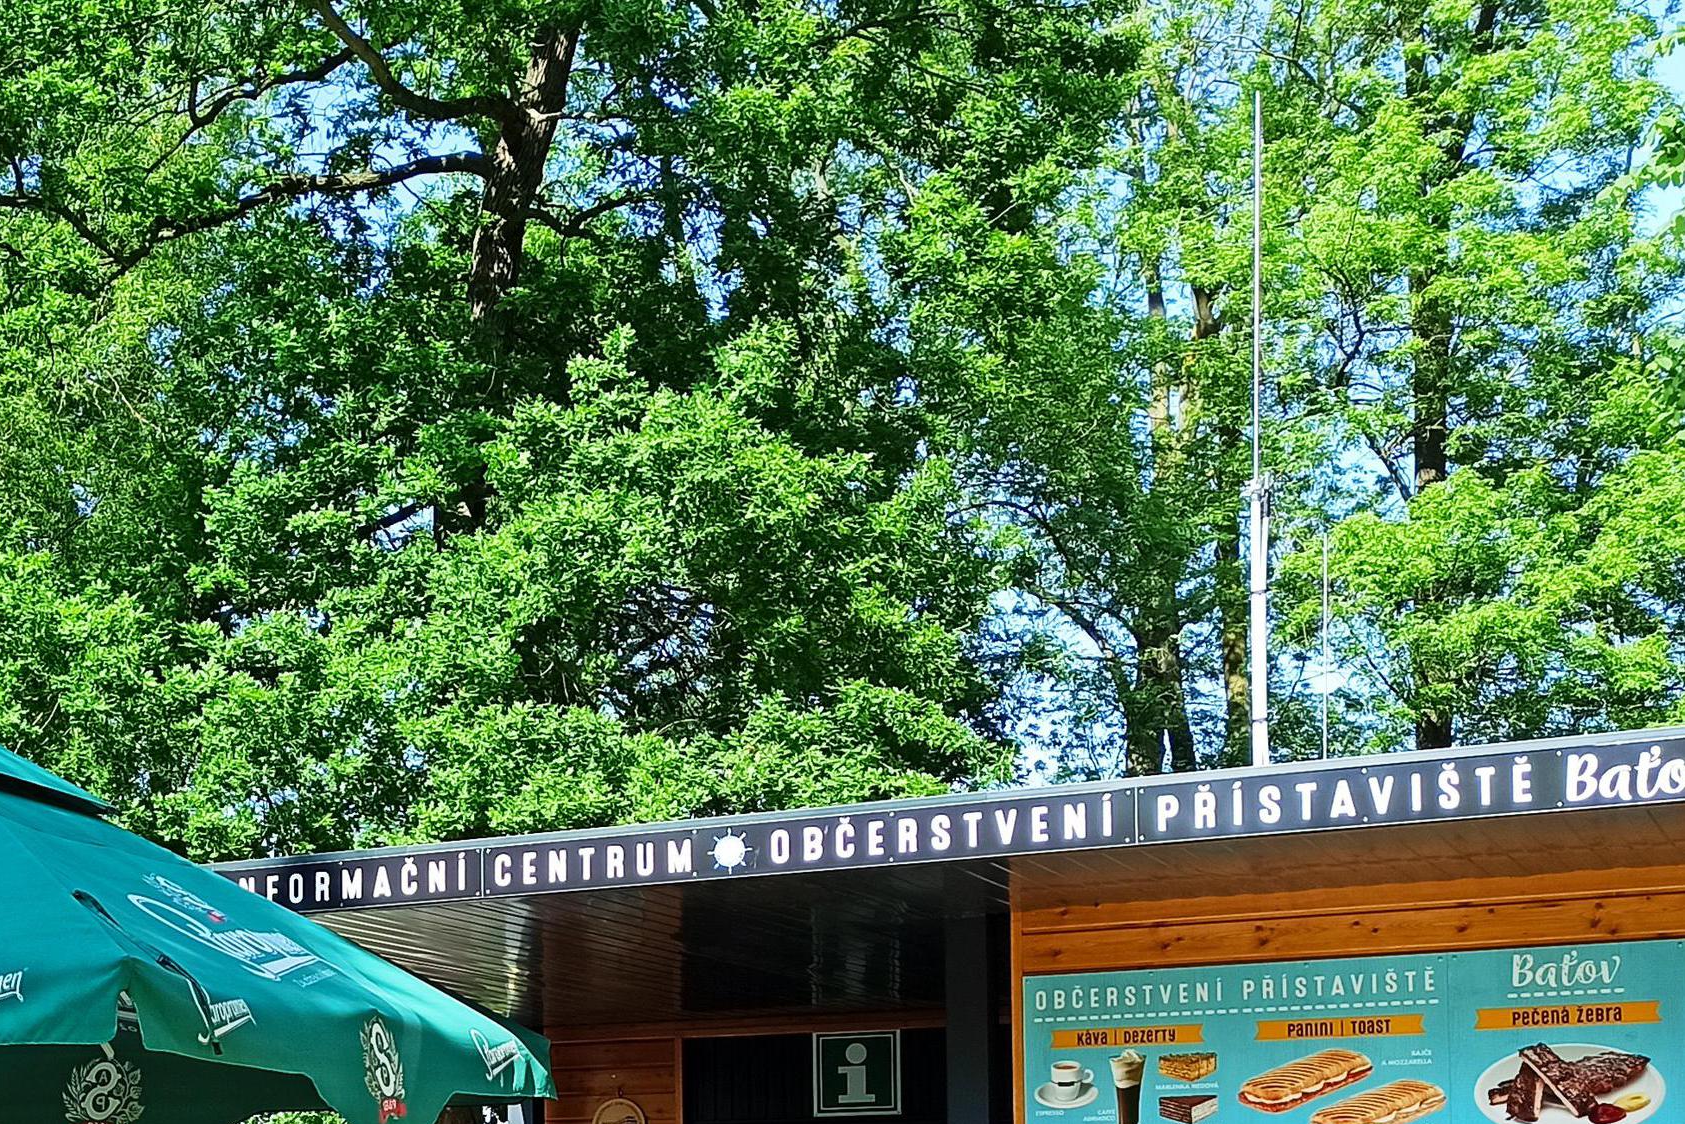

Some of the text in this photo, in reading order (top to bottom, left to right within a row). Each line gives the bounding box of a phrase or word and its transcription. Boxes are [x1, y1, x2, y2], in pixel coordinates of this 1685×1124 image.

[238, 745, 1685, 905] NFORMAČNÍ CENTRUM OBČERSTVENÍ PŘÍSTAVIŠTĚ Baťo
[1034, 966, 1438, 1011] OBČERSTVENÍ PŘÍSTAVIŠTĚ
[1511, 949, 1622, 988] Baťov
